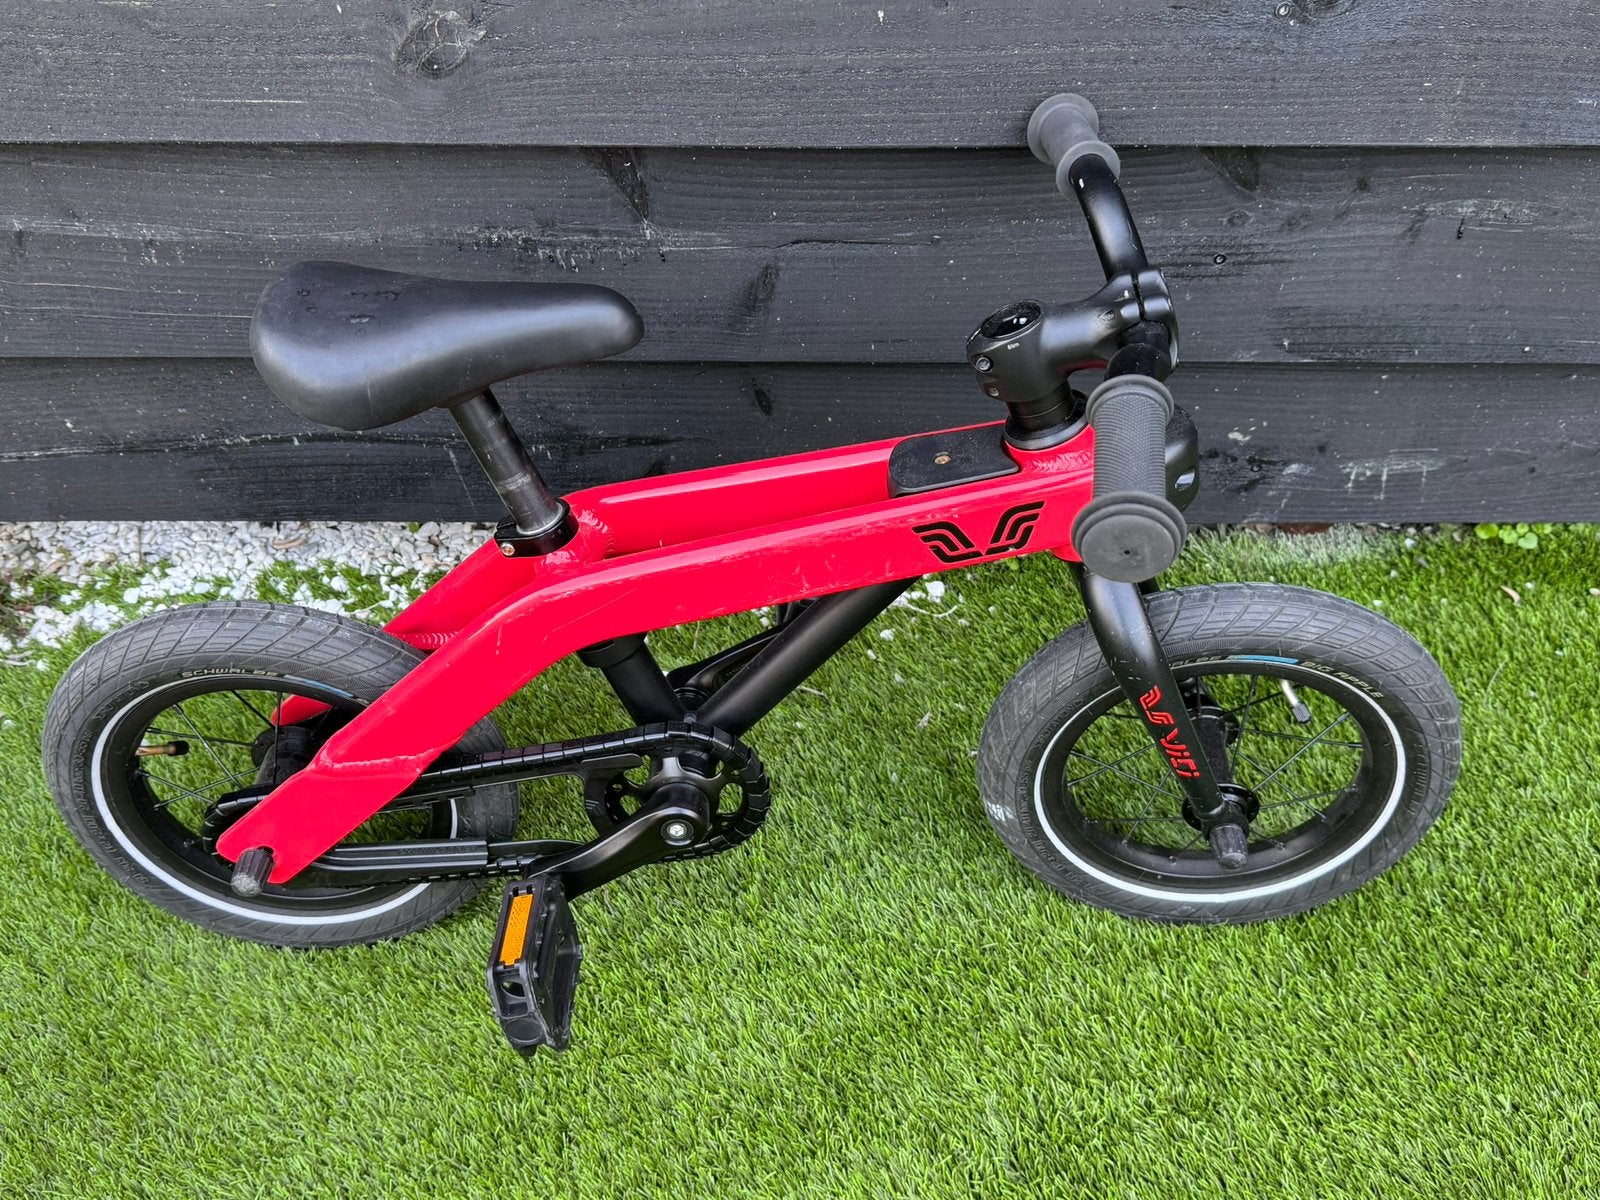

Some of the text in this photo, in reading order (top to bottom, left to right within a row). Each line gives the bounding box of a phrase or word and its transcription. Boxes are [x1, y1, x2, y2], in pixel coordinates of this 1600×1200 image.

[181, 667, 279, 678] SCHWALBE
[1301, 661, 1385, 698] BIG APPLE
